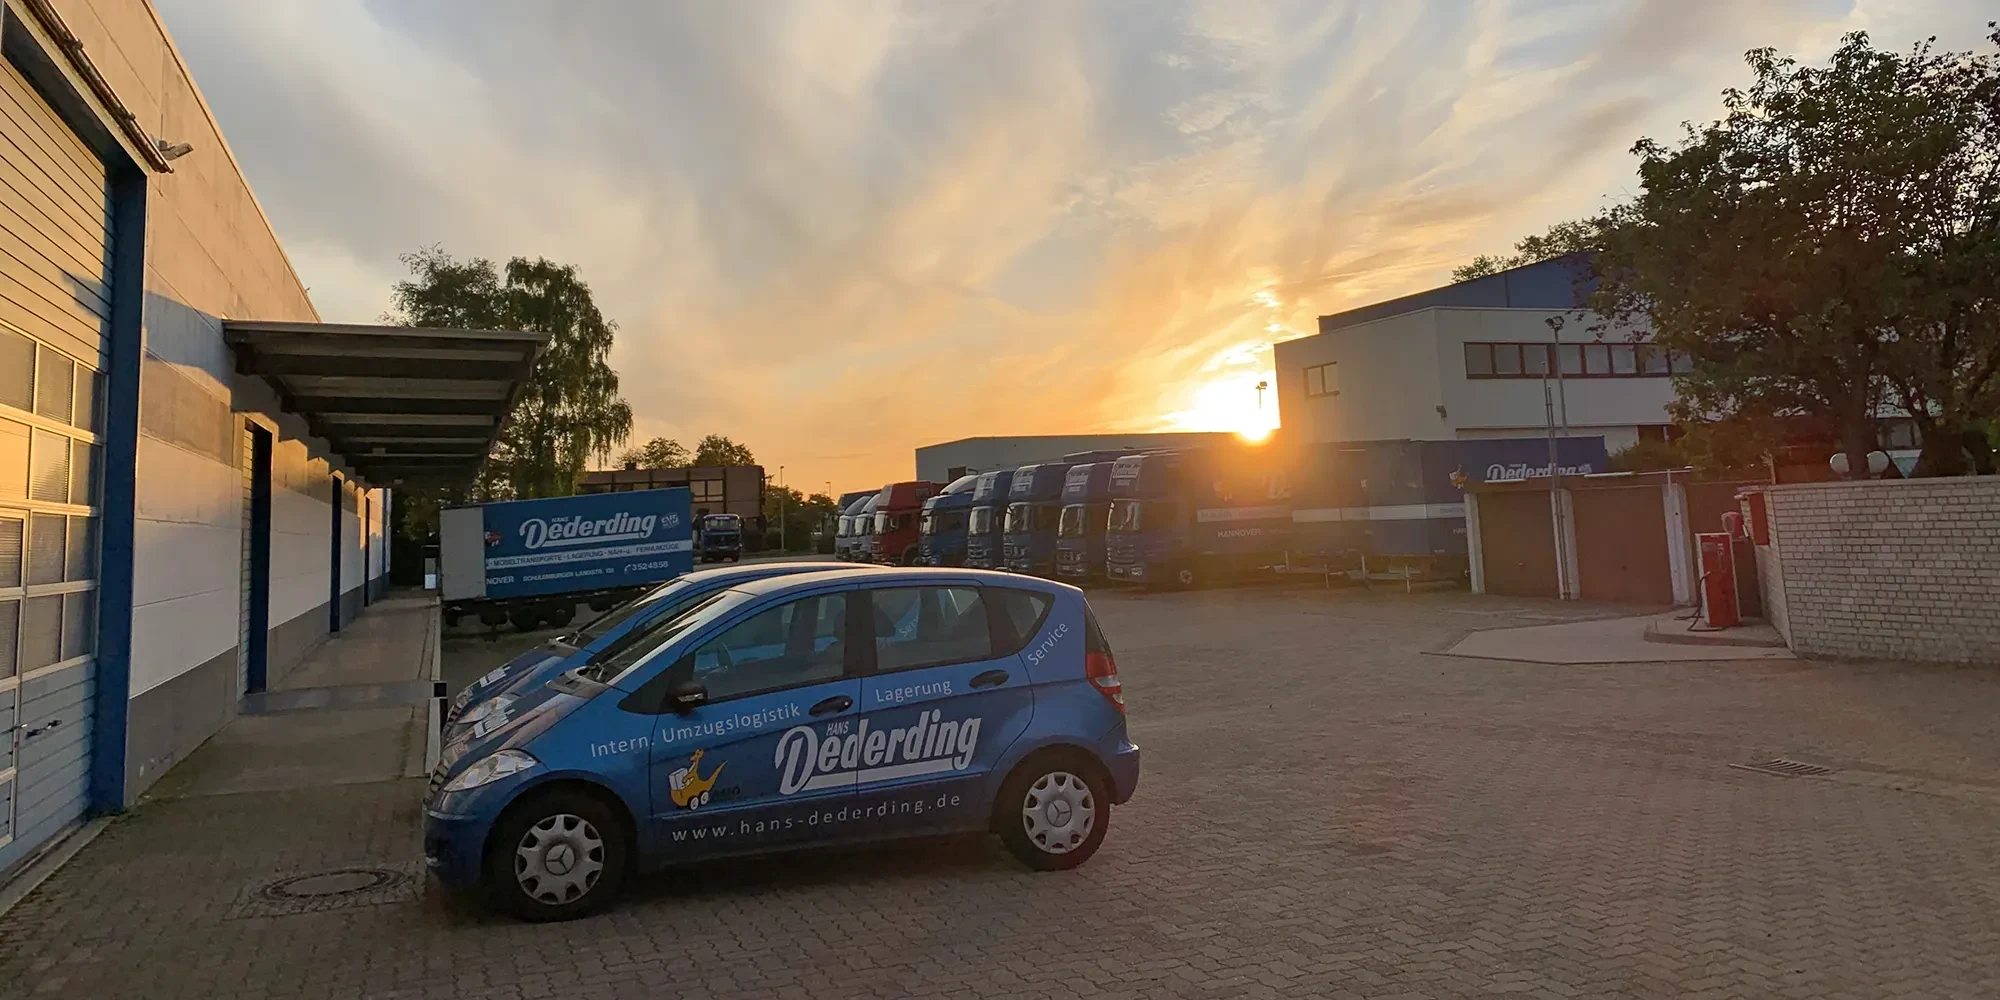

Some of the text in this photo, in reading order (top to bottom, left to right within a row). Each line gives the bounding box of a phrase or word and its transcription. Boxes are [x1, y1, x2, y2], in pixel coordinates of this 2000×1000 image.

[519, 511, 657, 549] Dederding
[1217, 528, 1262, 539] HANNOVER
[567, 548, 603, 561] LAGERUNG
[632, 560, 668, 572] 3524858
[1027, 623, 1069, 666] Service
[590, 680, 952, 758] Intern. Umzugslogistik Lagerung
[825, 721, 849, 736] HANS
[774, 708, 982, 795] Dederding
[672, 793, 960, 841] www.hans-dederding.de
